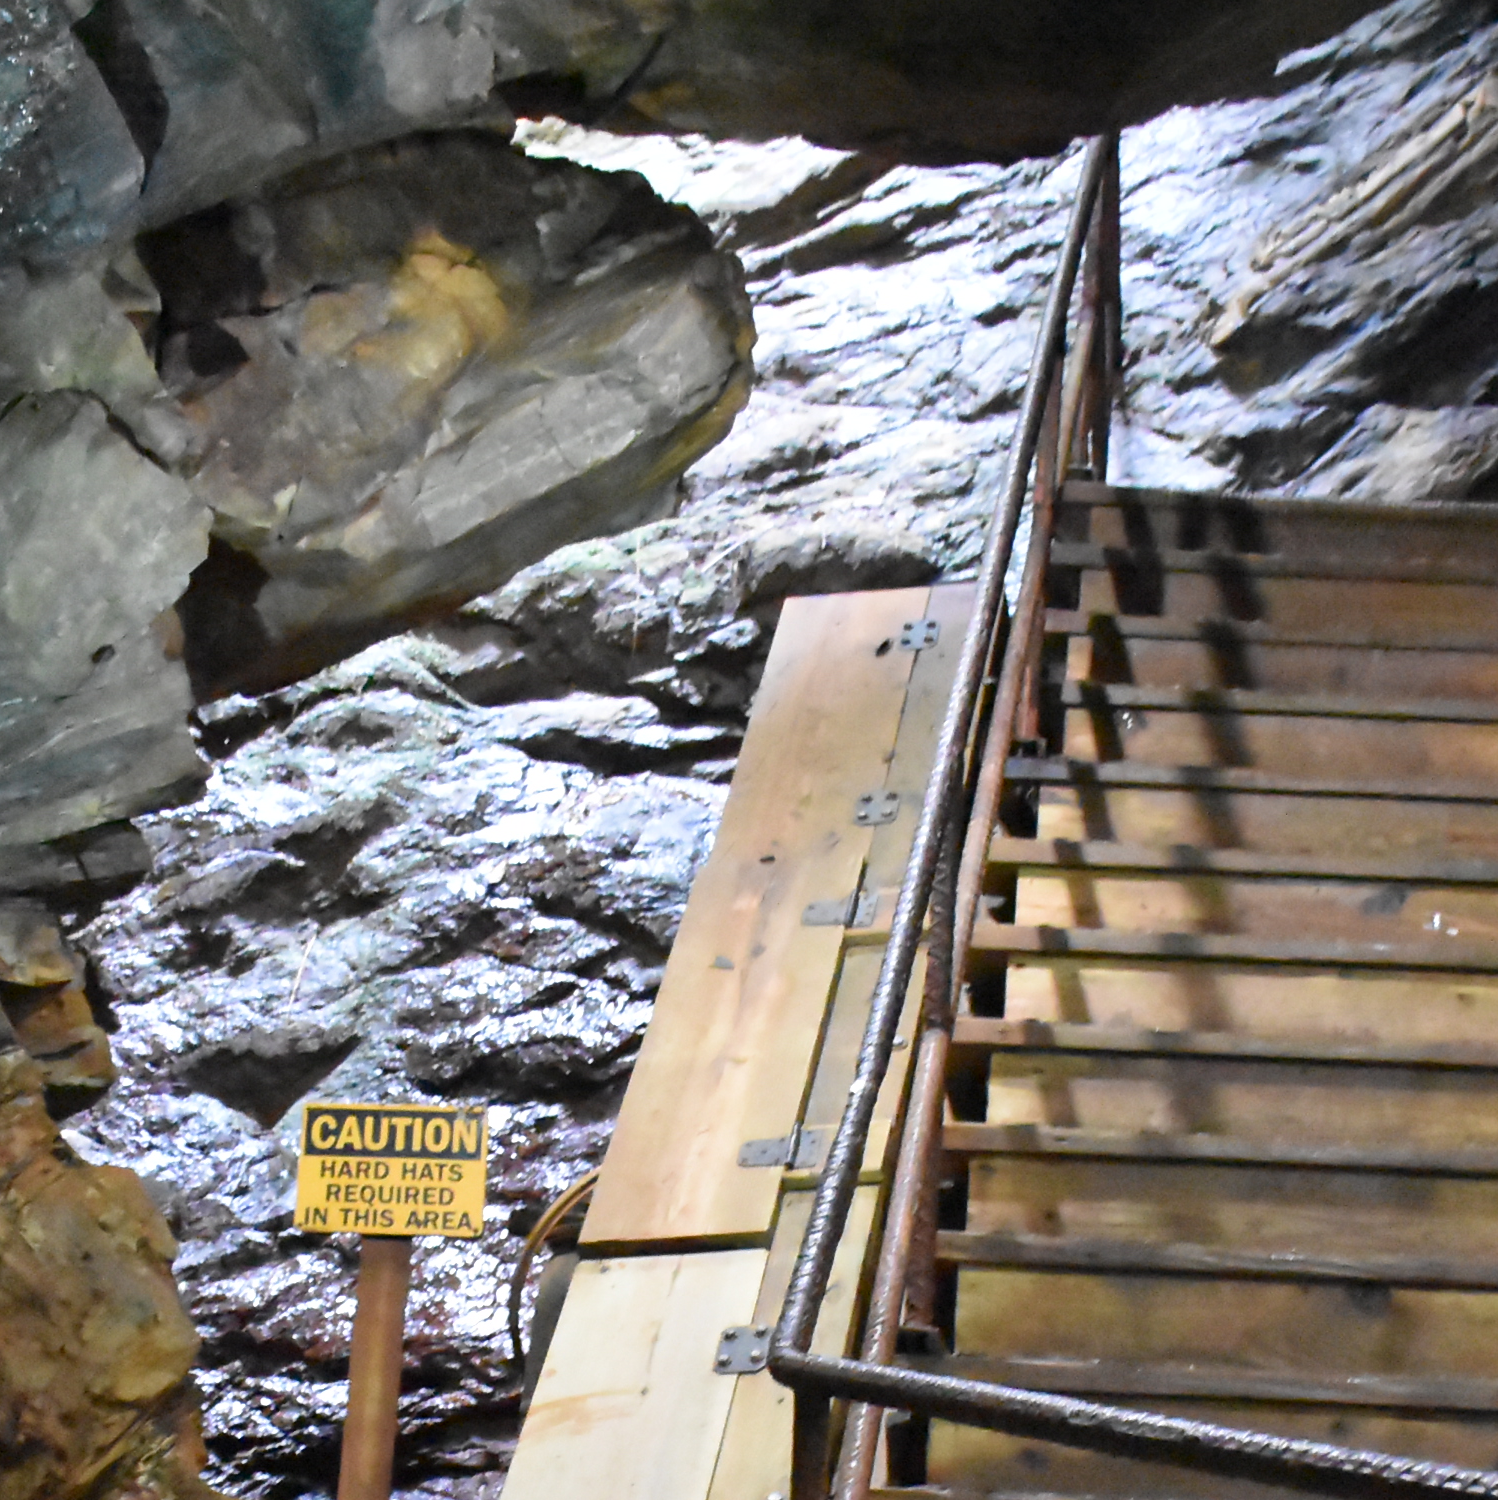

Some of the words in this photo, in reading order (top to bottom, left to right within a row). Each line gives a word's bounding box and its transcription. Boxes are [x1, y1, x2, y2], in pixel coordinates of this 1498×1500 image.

[311, 1115, 478, 1152] CAUTION
[321, 1161, 389, 1179] HARD
[402, 1164, 463, 1182] HATS
[326, 1185, 454, 1206] REQUIRED
[305, 1207, 328, 1225] IN
[341, 1209, 394, 1227] THIS
[406, 1212, 472, 1231] AREA
